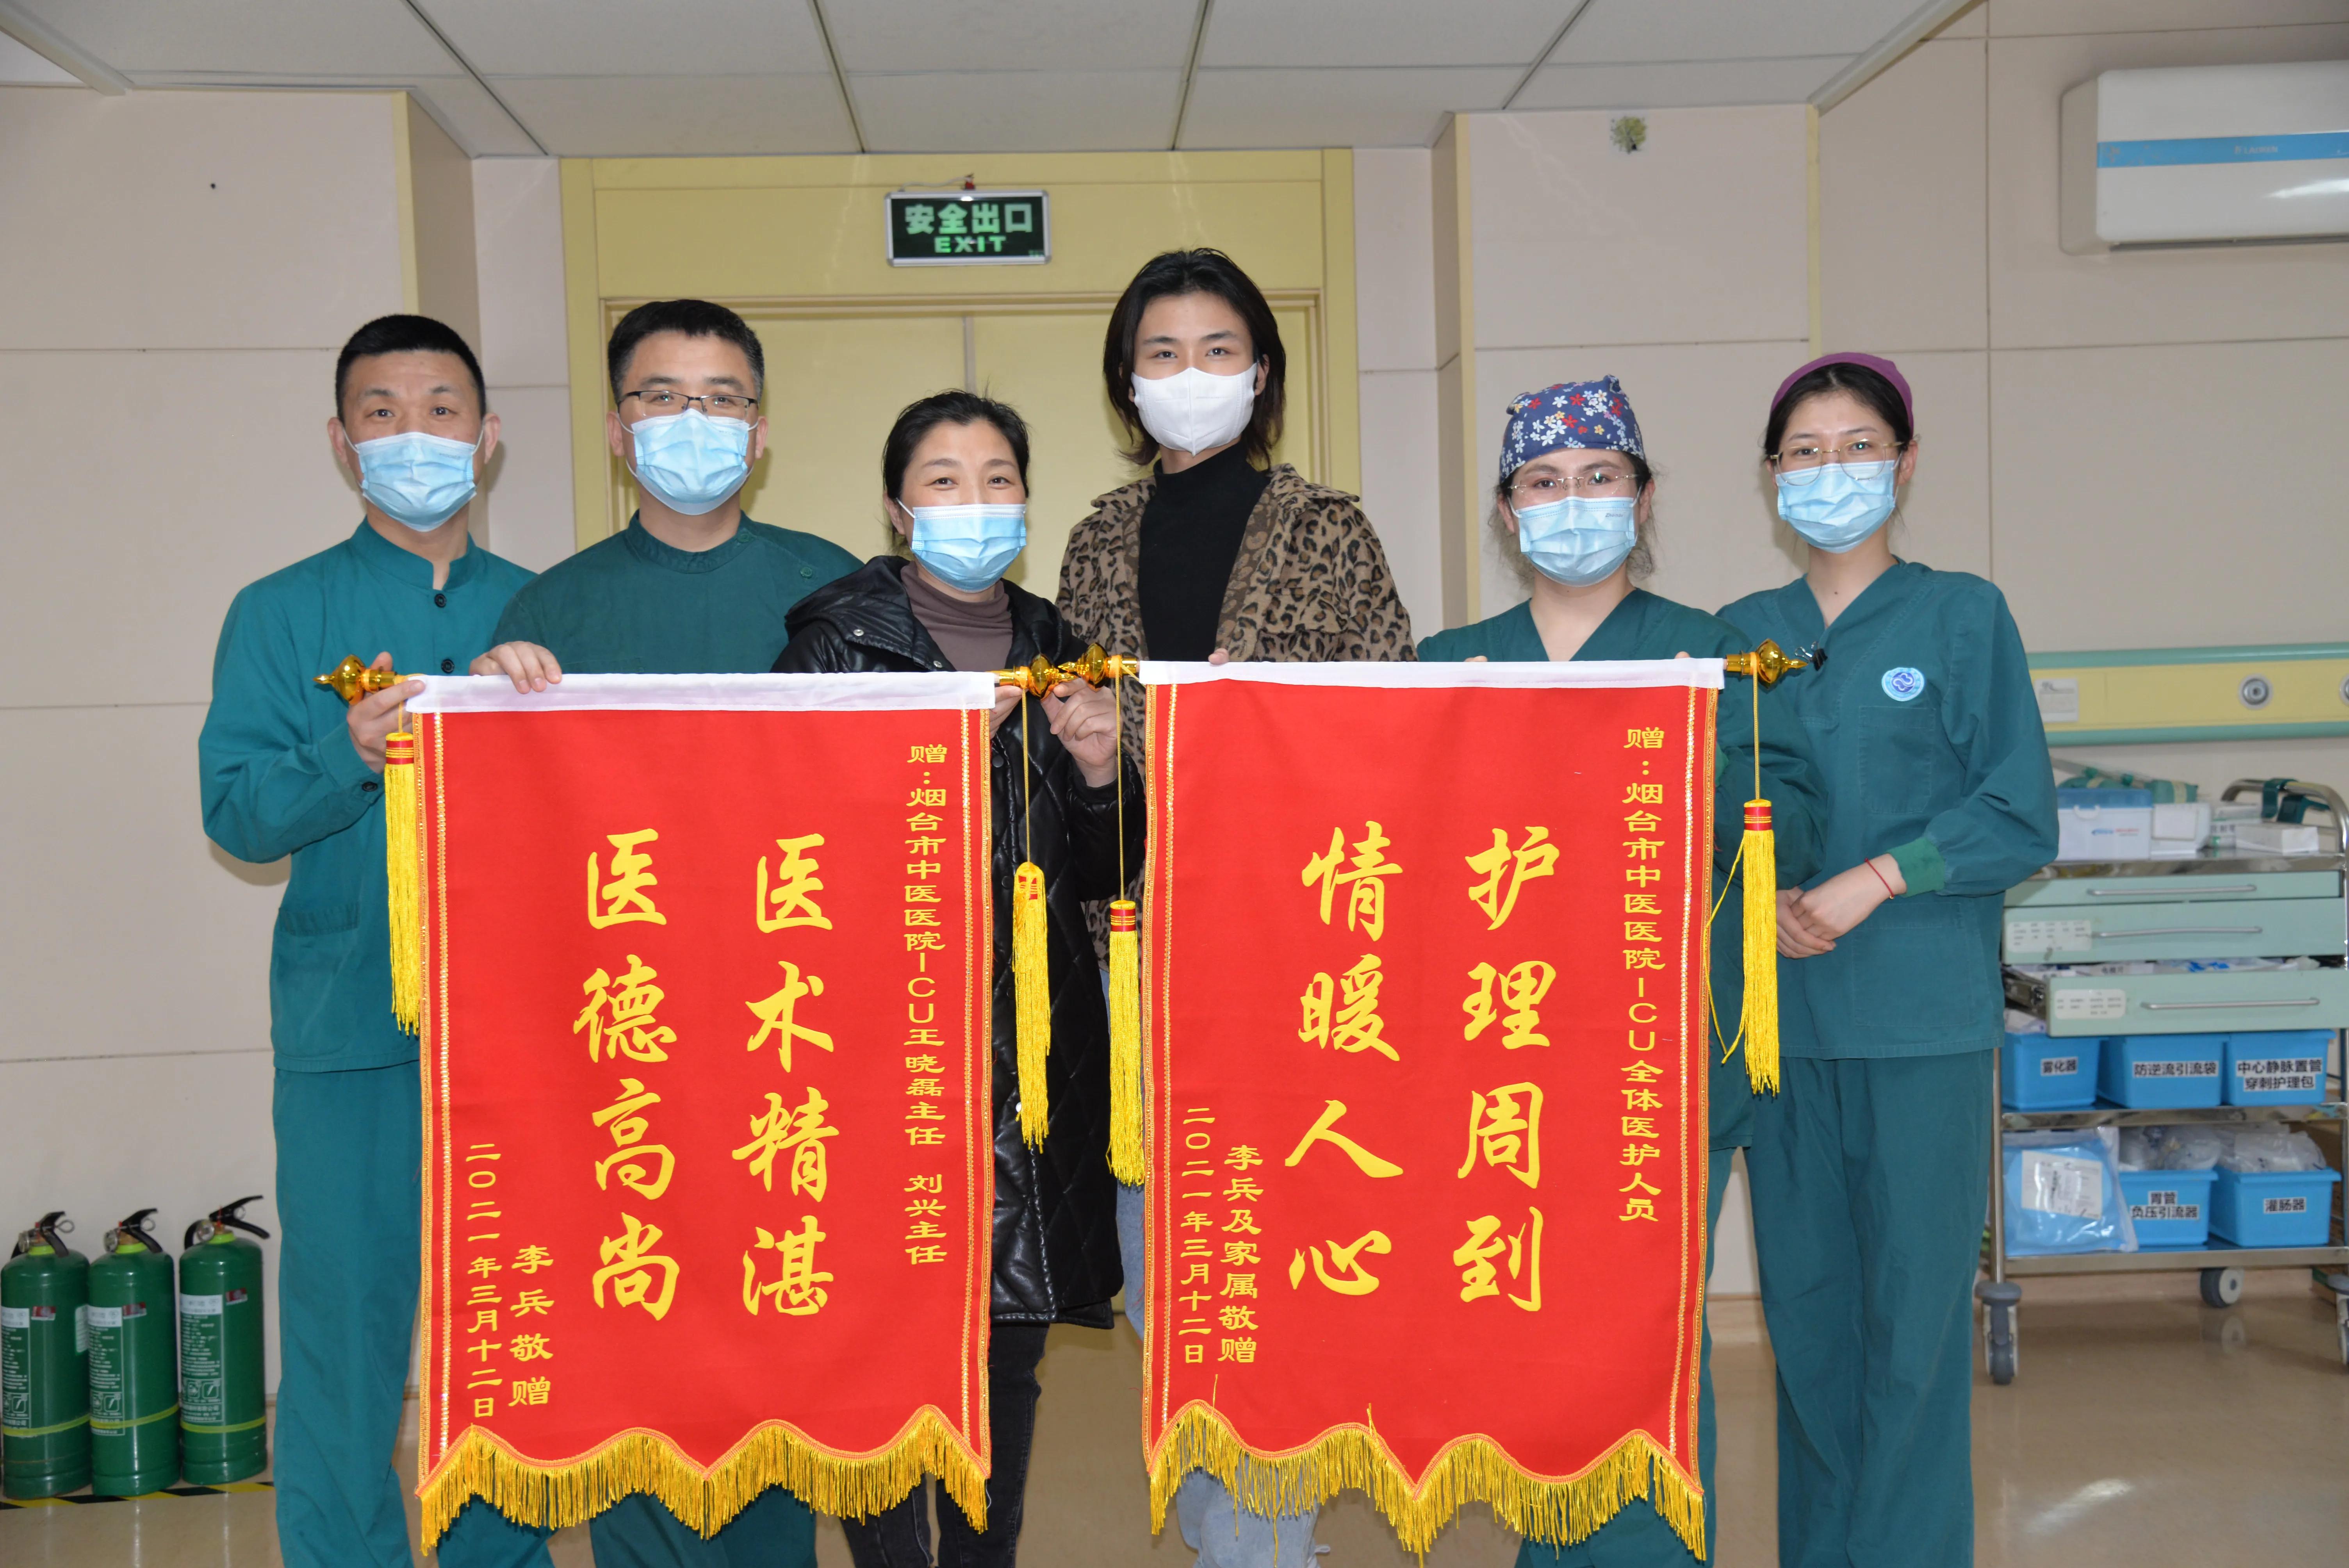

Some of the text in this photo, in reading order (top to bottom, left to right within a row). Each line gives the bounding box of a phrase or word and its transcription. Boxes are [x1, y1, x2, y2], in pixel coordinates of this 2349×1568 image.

[905, 203, 1033, 234] 安全出口
[934, 235, 1006, 253] EXIT
[1619, 727, 1665, 1222] 赠：烟台市中医医院ICU全体医护人员
[1285, 820, 1403, 1295] 情暖人心
[1453, 826, 1559, 1311] 护理周到
[2042, 1059, 2077, 1073] 雾化器
[2133, 1062, 2217, 1076] 防逆流引流袋
[2238, 1059, 2322, 1074] 中心静脉置管
[573, 828, 680, 1321] 医德高尚
[732, 833, 839, 1316] 医术精湛
[2245, 1076, 2314, 1090] 穿刺护理包
[2132, 1206, 2198, 1219] 负压引流器
[2151, 1192, 2177, 1205] 胃管
[2265, 1198, 2304, 1212] 灌肠器
[904, 1174, 948, 1265] 刘兴主任
[1217, 1144, 1264, 1363] 李兵及家属敬赠
[508, 1245, 554, 1406] 李兵敬赠
